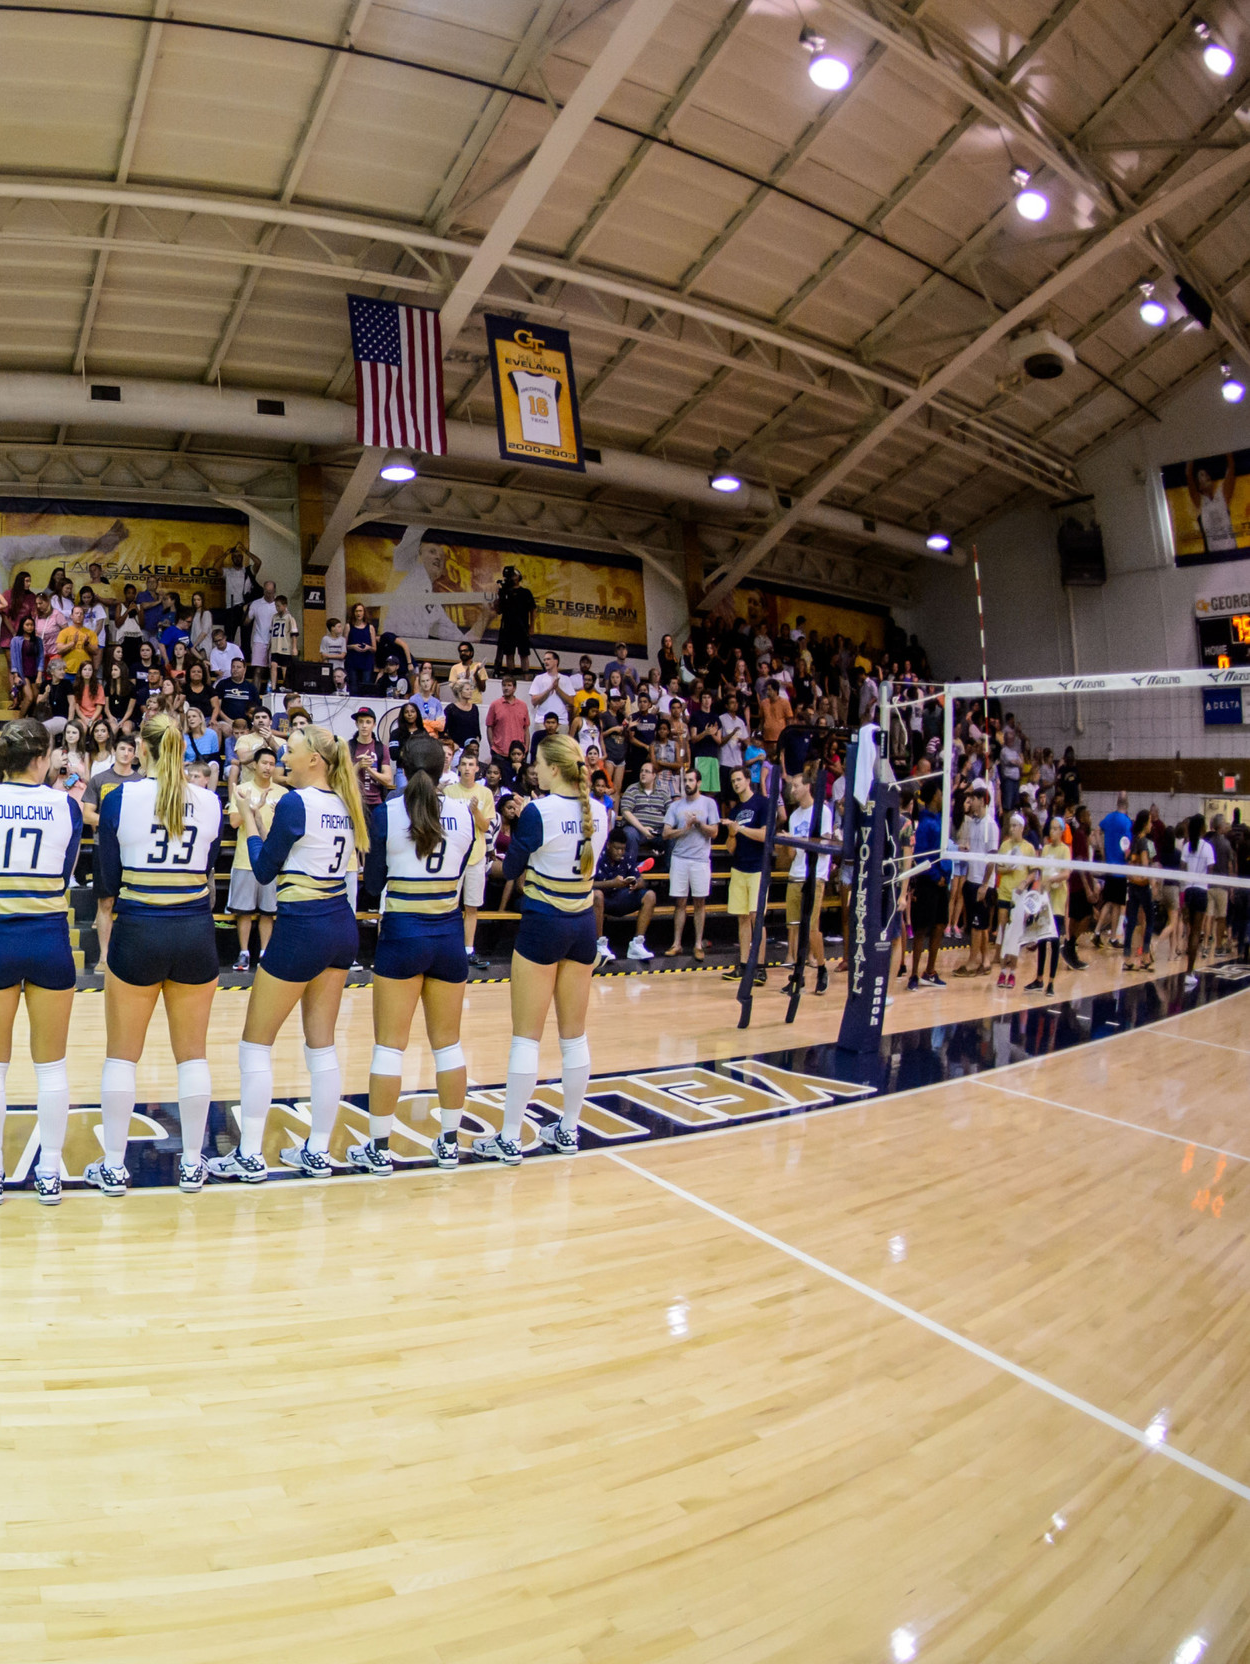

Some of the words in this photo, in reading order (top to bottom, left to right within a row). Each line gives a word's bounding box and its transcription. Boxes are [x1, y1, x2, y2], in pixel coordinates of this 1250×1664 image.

[505, 357, 561, 374] EVELAND
[528, 395, 550, 417] 16
[508, 442, 577, 460] 2000-2003
[545, 598, 637, 617] STEGEMANN
[1211, 593, 1250, 611] GEORG
[272, 623, 286, 637] 21
[1204, 644, 1228, 656] HOME
[1212, 700, 1241, 710] DELTA
[561, 820, 578, 835] VAN
[3, 827, 43, 869] 17
[147, 823, 198, 865] 33
[328, 835, 346, 873] 3
[425, 838, 447, 874] 8
[852, 826, 872, 995] VOLLEYBALL
